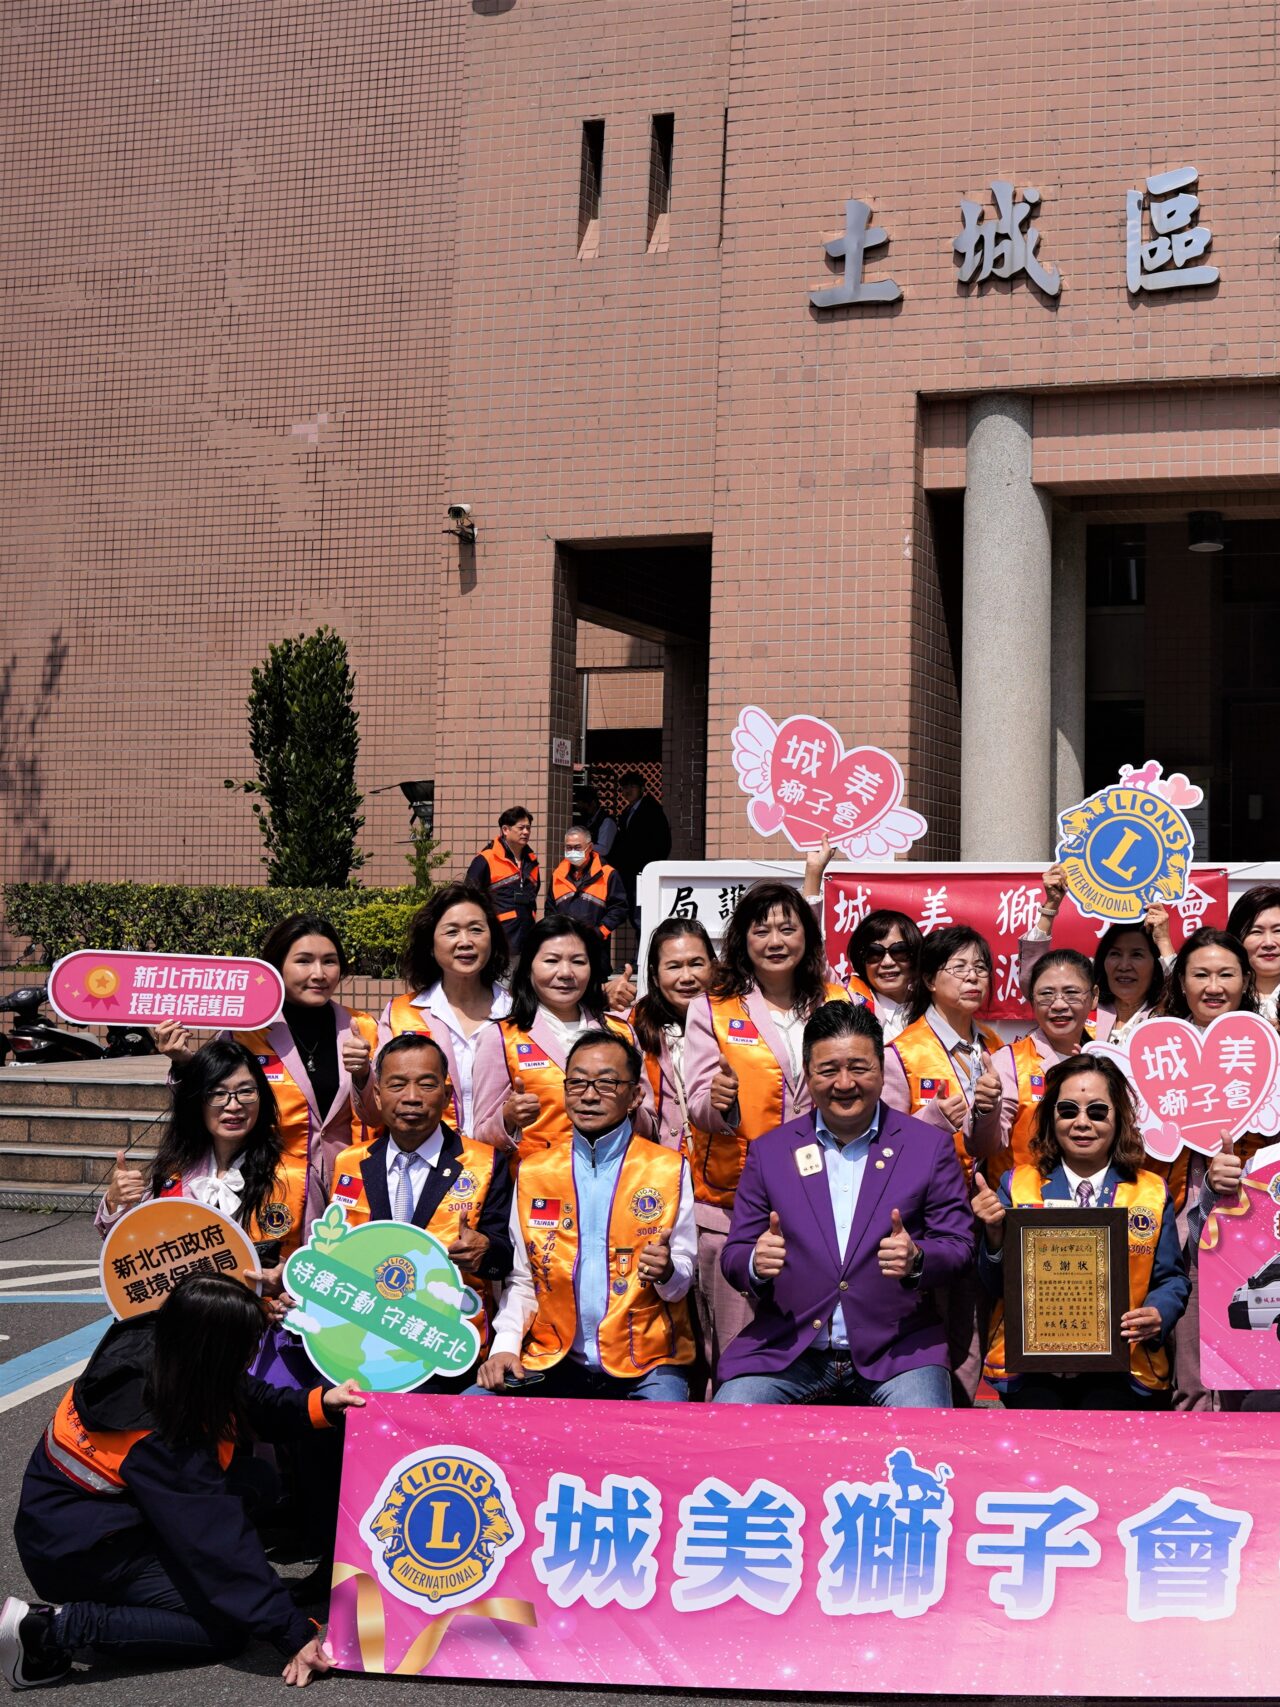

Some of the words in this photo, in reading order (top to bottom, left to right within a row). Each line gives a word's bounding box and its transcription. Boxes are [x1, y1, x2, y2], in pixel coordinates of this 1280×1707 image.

[777, 778, 861, 829] 獅子會
[1114, 793, 1184, 845] LIONS
[1101, 826, 1143, 881] L
[1066, 863, 1135, 913] INTERNATIONAL
[132, 965, 250, 991] 新北市政府
[128, 992, 246, 1018] 環境保護局
[1158, 1078, 1252, 1116] 獅子會
[335, 1195, 354, 1205] TAIWAN
[534, 1219, 555, 1227] TAIWAN
[111, 1223, 226, 1280] 新北市政府
[389, 1258, 414, 1275] LIONS
[1043, 1260, 1089, 1272] 感謝狀
[388, 1269, 401, 1288] L
[291, 1259, 378, 1316] 持續行動
[380, 1305, 468, 1363] 守護新北
[407, 1462, 487, 1492] LIONS
[425, 1501, 461, 1550] L
[398, 1562, 478, 1590] INTERNATIONAL
